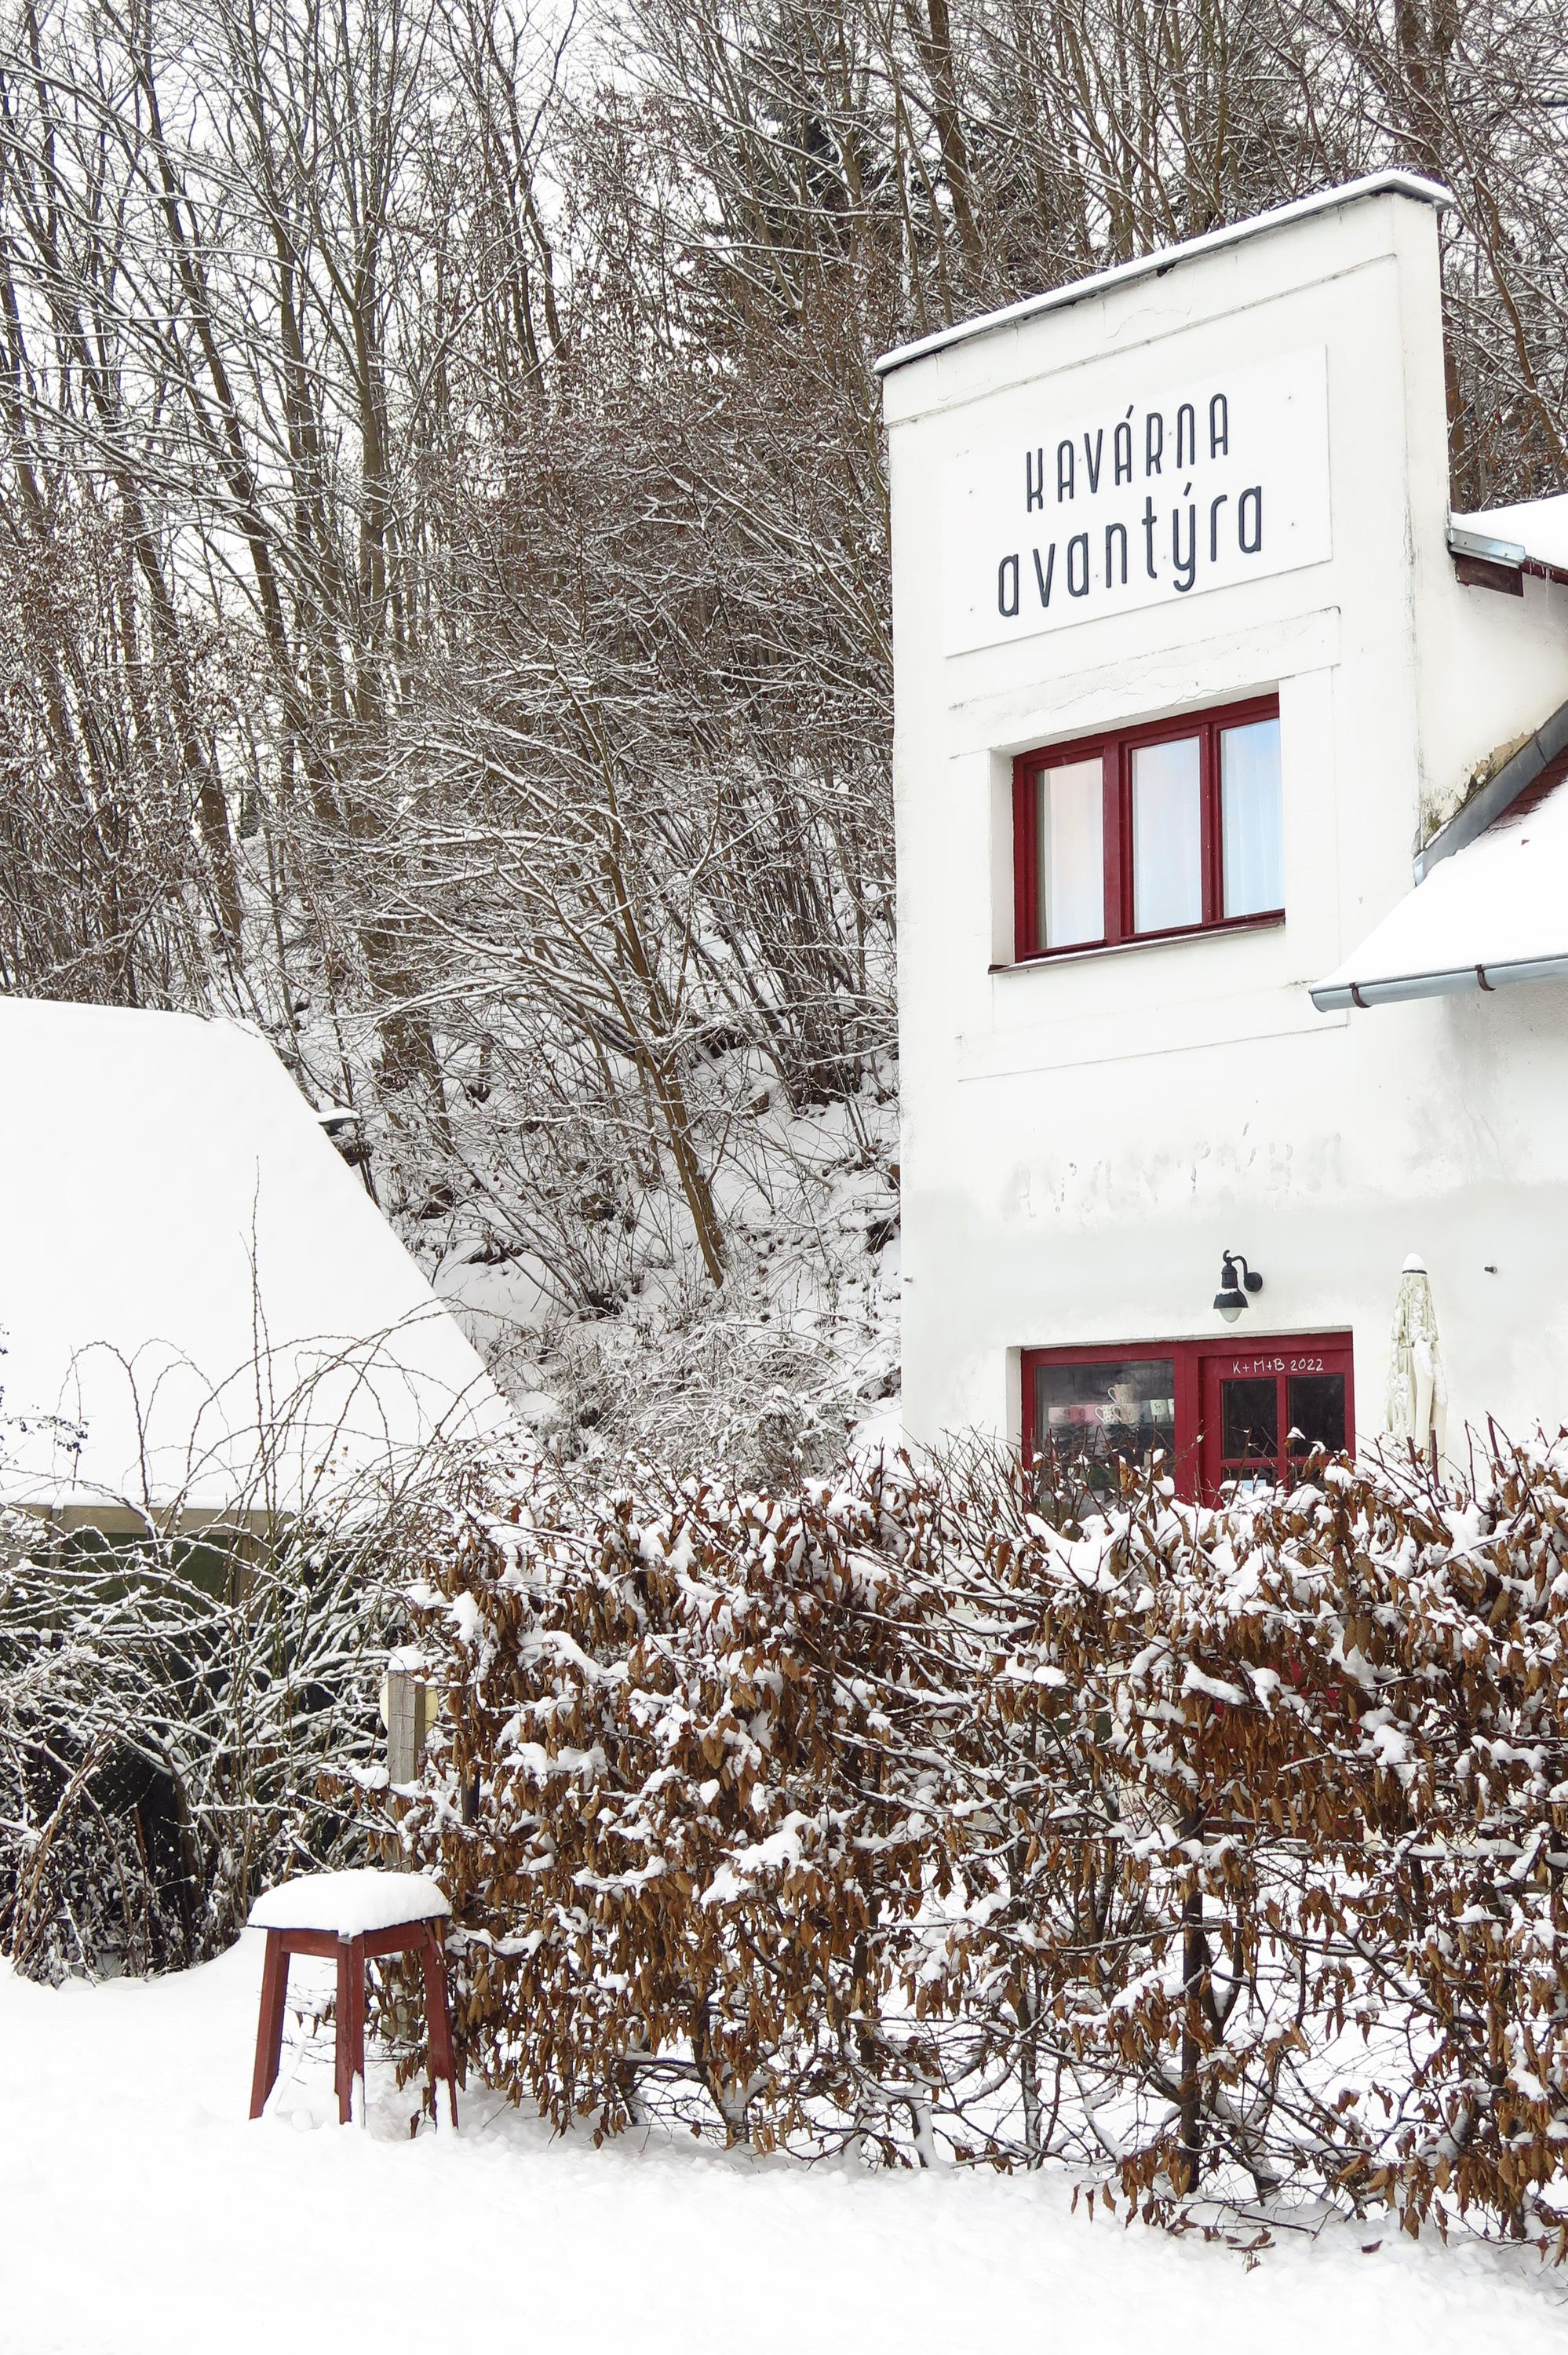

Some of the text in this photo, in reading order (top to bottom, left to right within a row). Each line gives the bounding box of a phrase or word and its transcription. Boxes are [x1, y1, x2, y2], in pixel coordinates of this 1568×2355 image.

[1026, 393, 1228, 513] KAVÁRNA
[998, 481, 1262, 618] avantýra
[1290, 1358, 1324, 1371] 2022
